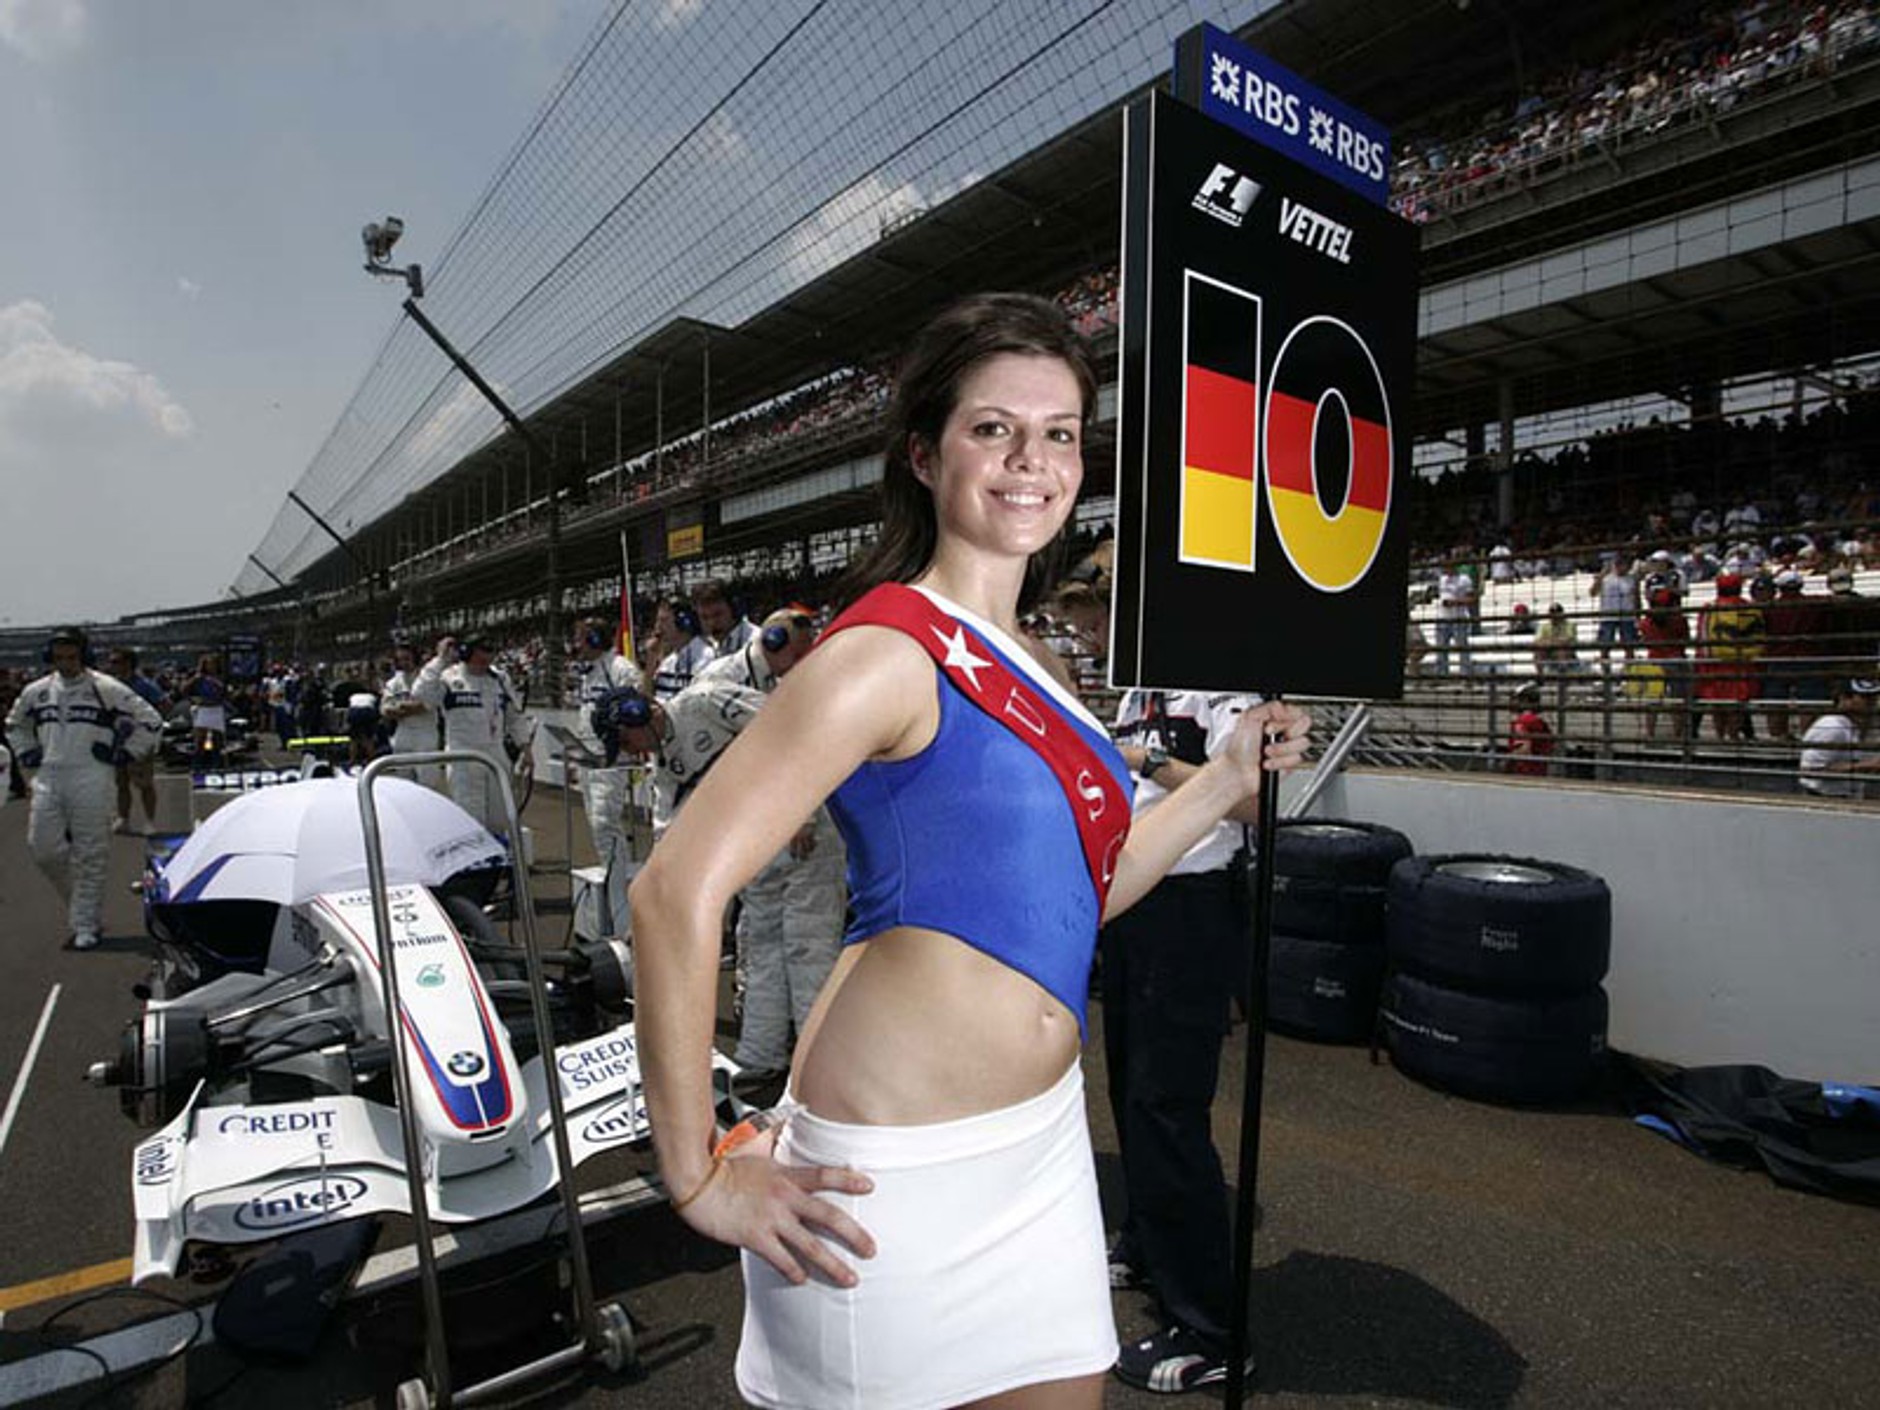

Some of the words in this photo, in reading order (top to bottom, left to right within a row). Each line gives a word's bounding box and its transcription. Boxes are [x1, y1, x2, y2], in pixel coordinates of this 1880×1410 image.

[1244, 69, 1300, 136] RBS
[1336, 122, 1384, 182] RBS
[1199, 163, 1262, 216] F1
[1279, 197, 1353, 264] VETTEL
[1178, 267, 1394, 593] 10
[558, 1036, 637, 1074] CREDI
[571, 1056, 635, 1091] SUIS
[219, 1110, 337, 1135] CREDIT
[252, 1184, 347, 1218] intel
